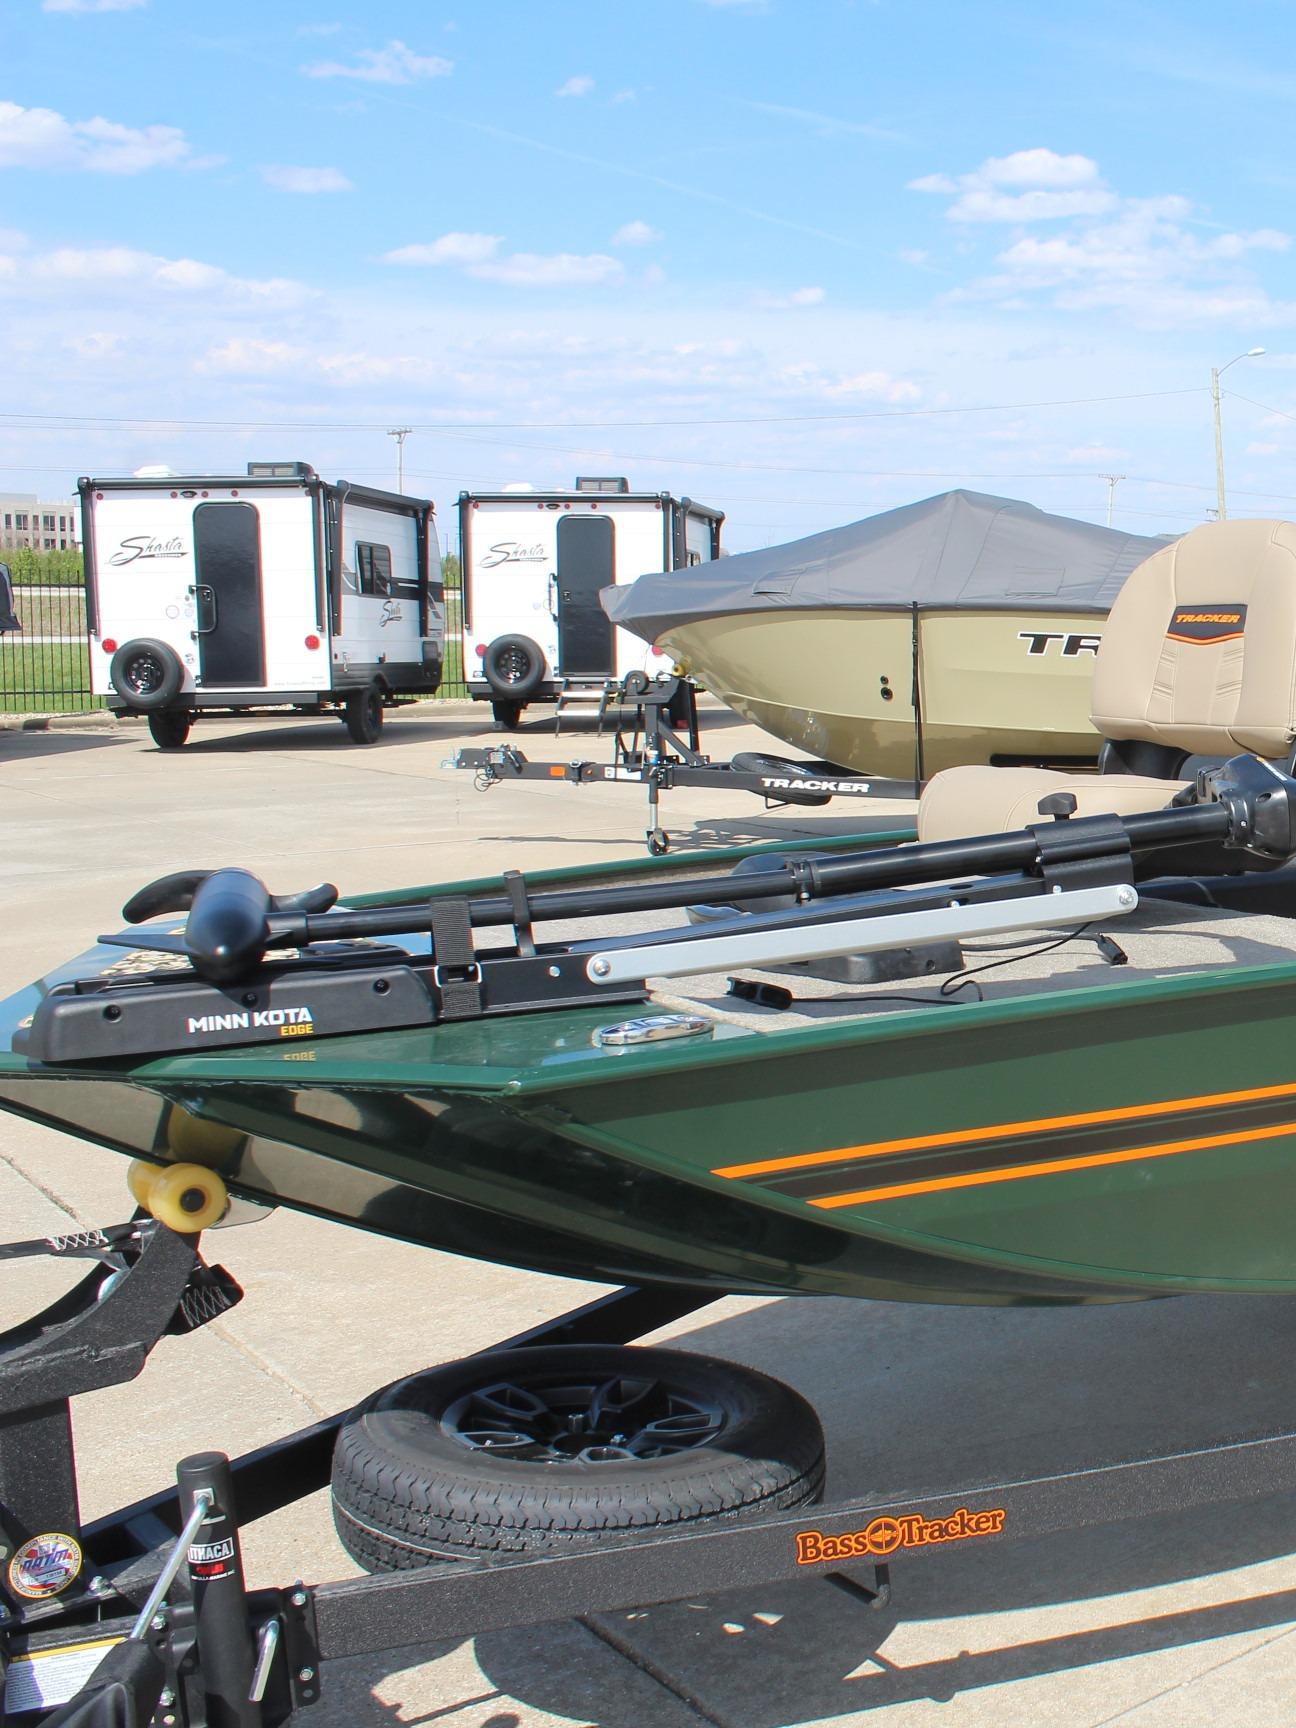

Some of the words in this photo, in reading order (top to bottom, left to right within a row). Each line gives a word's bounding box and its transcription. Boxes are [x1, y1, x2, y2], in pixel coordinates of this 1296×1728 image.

[104, 536, 184, 566] Shasta
[478, 542, 545, 568] Shasta
[1175, 614, 1241, 624] TRACKER
[761, 778, 870, 792] TRACKER
[188, 1013, 249, 1033] MINN
[253, 1007, 313, 1027] KOTA
[280, 1023, 314, 1036] EDGE
[797, 1531, 868, 1564] Bass
[899, 1508, 1006, 1547] Tracker
[189, 1541, 231, 1561] ITHACA
